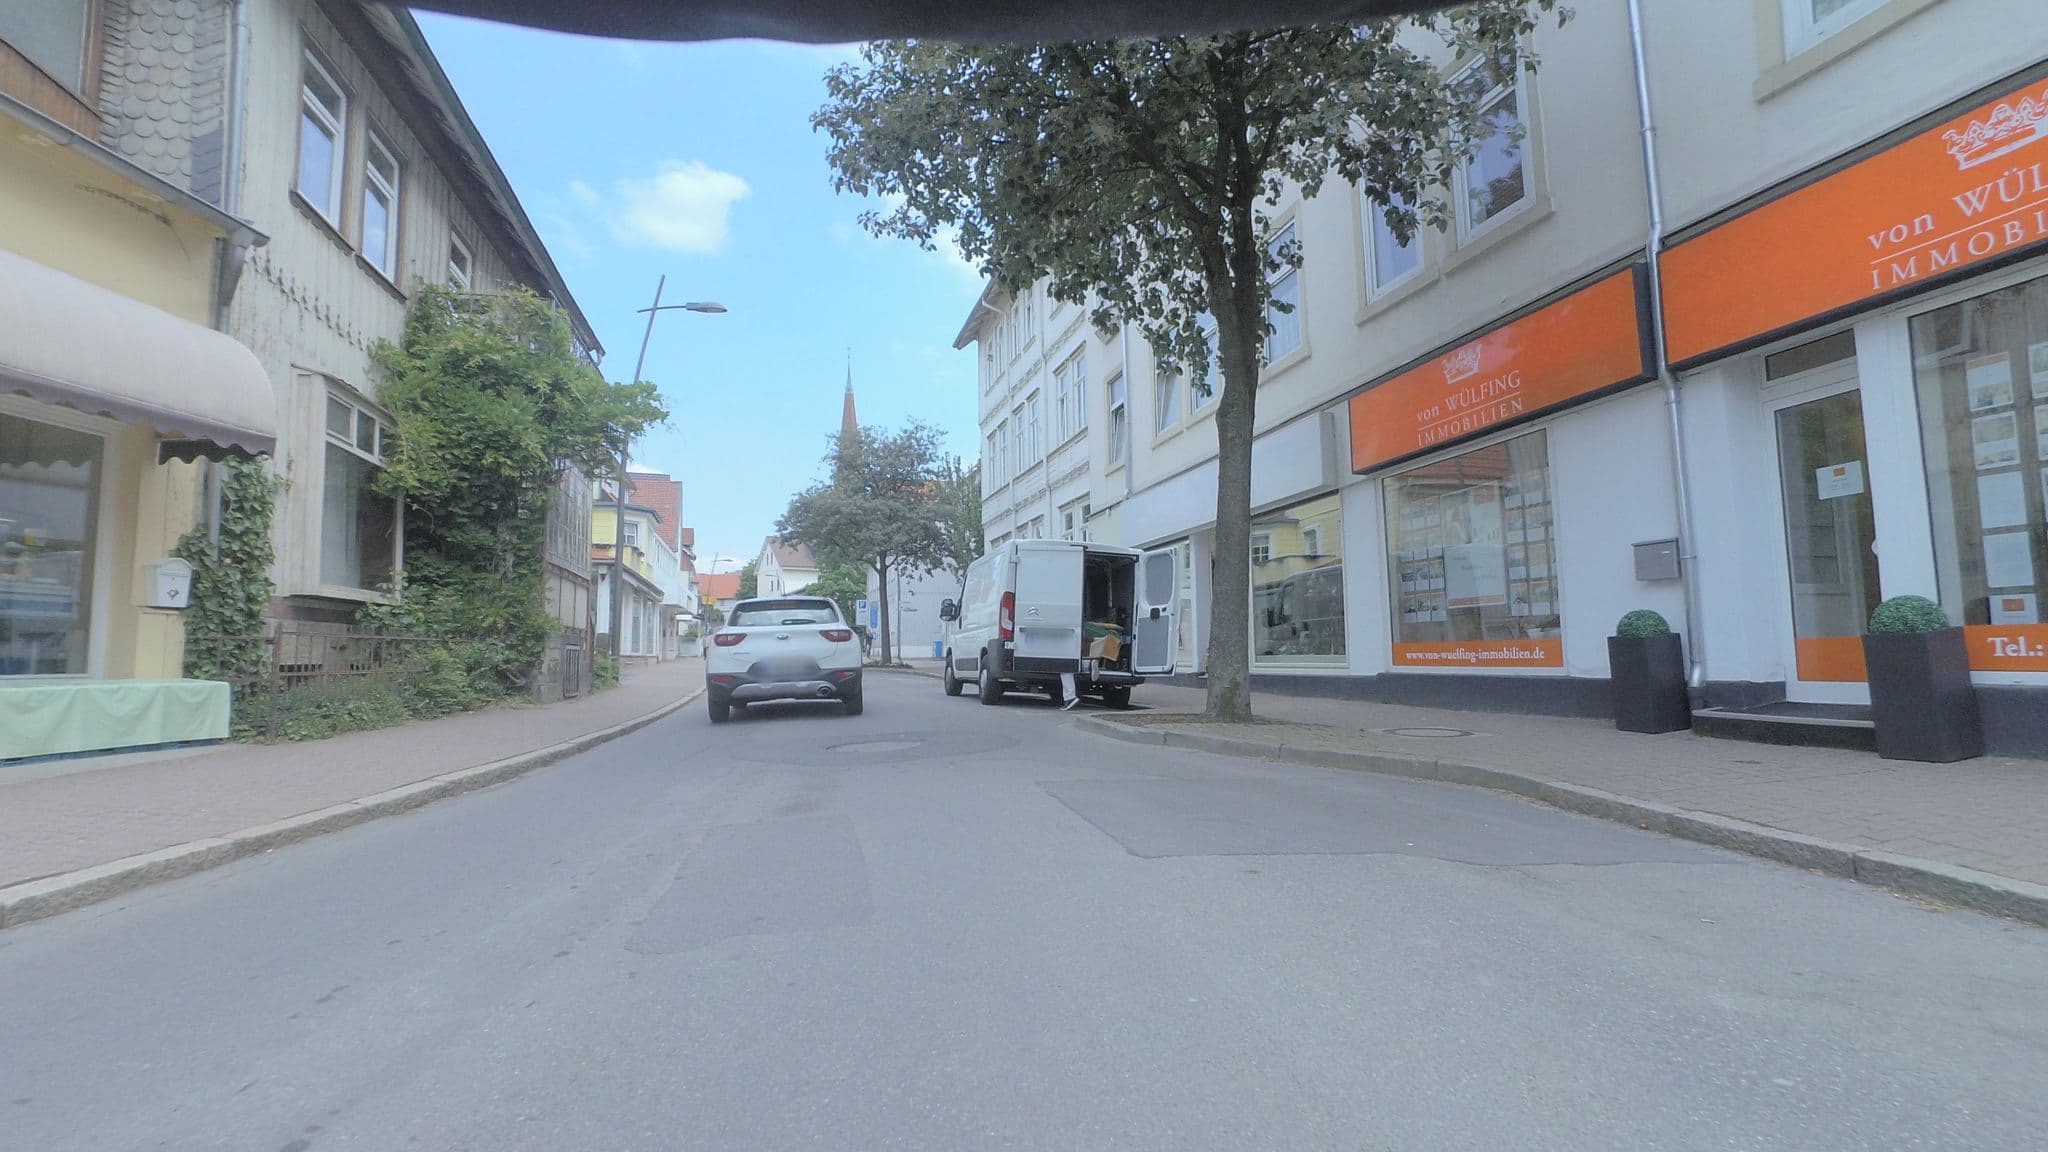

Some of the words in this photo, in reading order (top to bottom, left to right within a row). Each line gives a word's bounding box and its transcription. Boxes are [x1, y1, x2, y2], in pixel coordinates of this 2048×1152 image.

[1868, 213, 1935, 250] von
[1952, 163, 2048, 217] WÜL
[1872, 211, 2048, 290] IMMOBI
[1417, 405, 1440, 423] von
[1445, 369, 1521, 412] WÜLFING
[1418, 397, 1522, 447] IMMOBILIEN
[1406, 647, 1545, 663] www.von-wuelfing-immobilien.de
[1987, 636, 2044, 657] Tel.:
